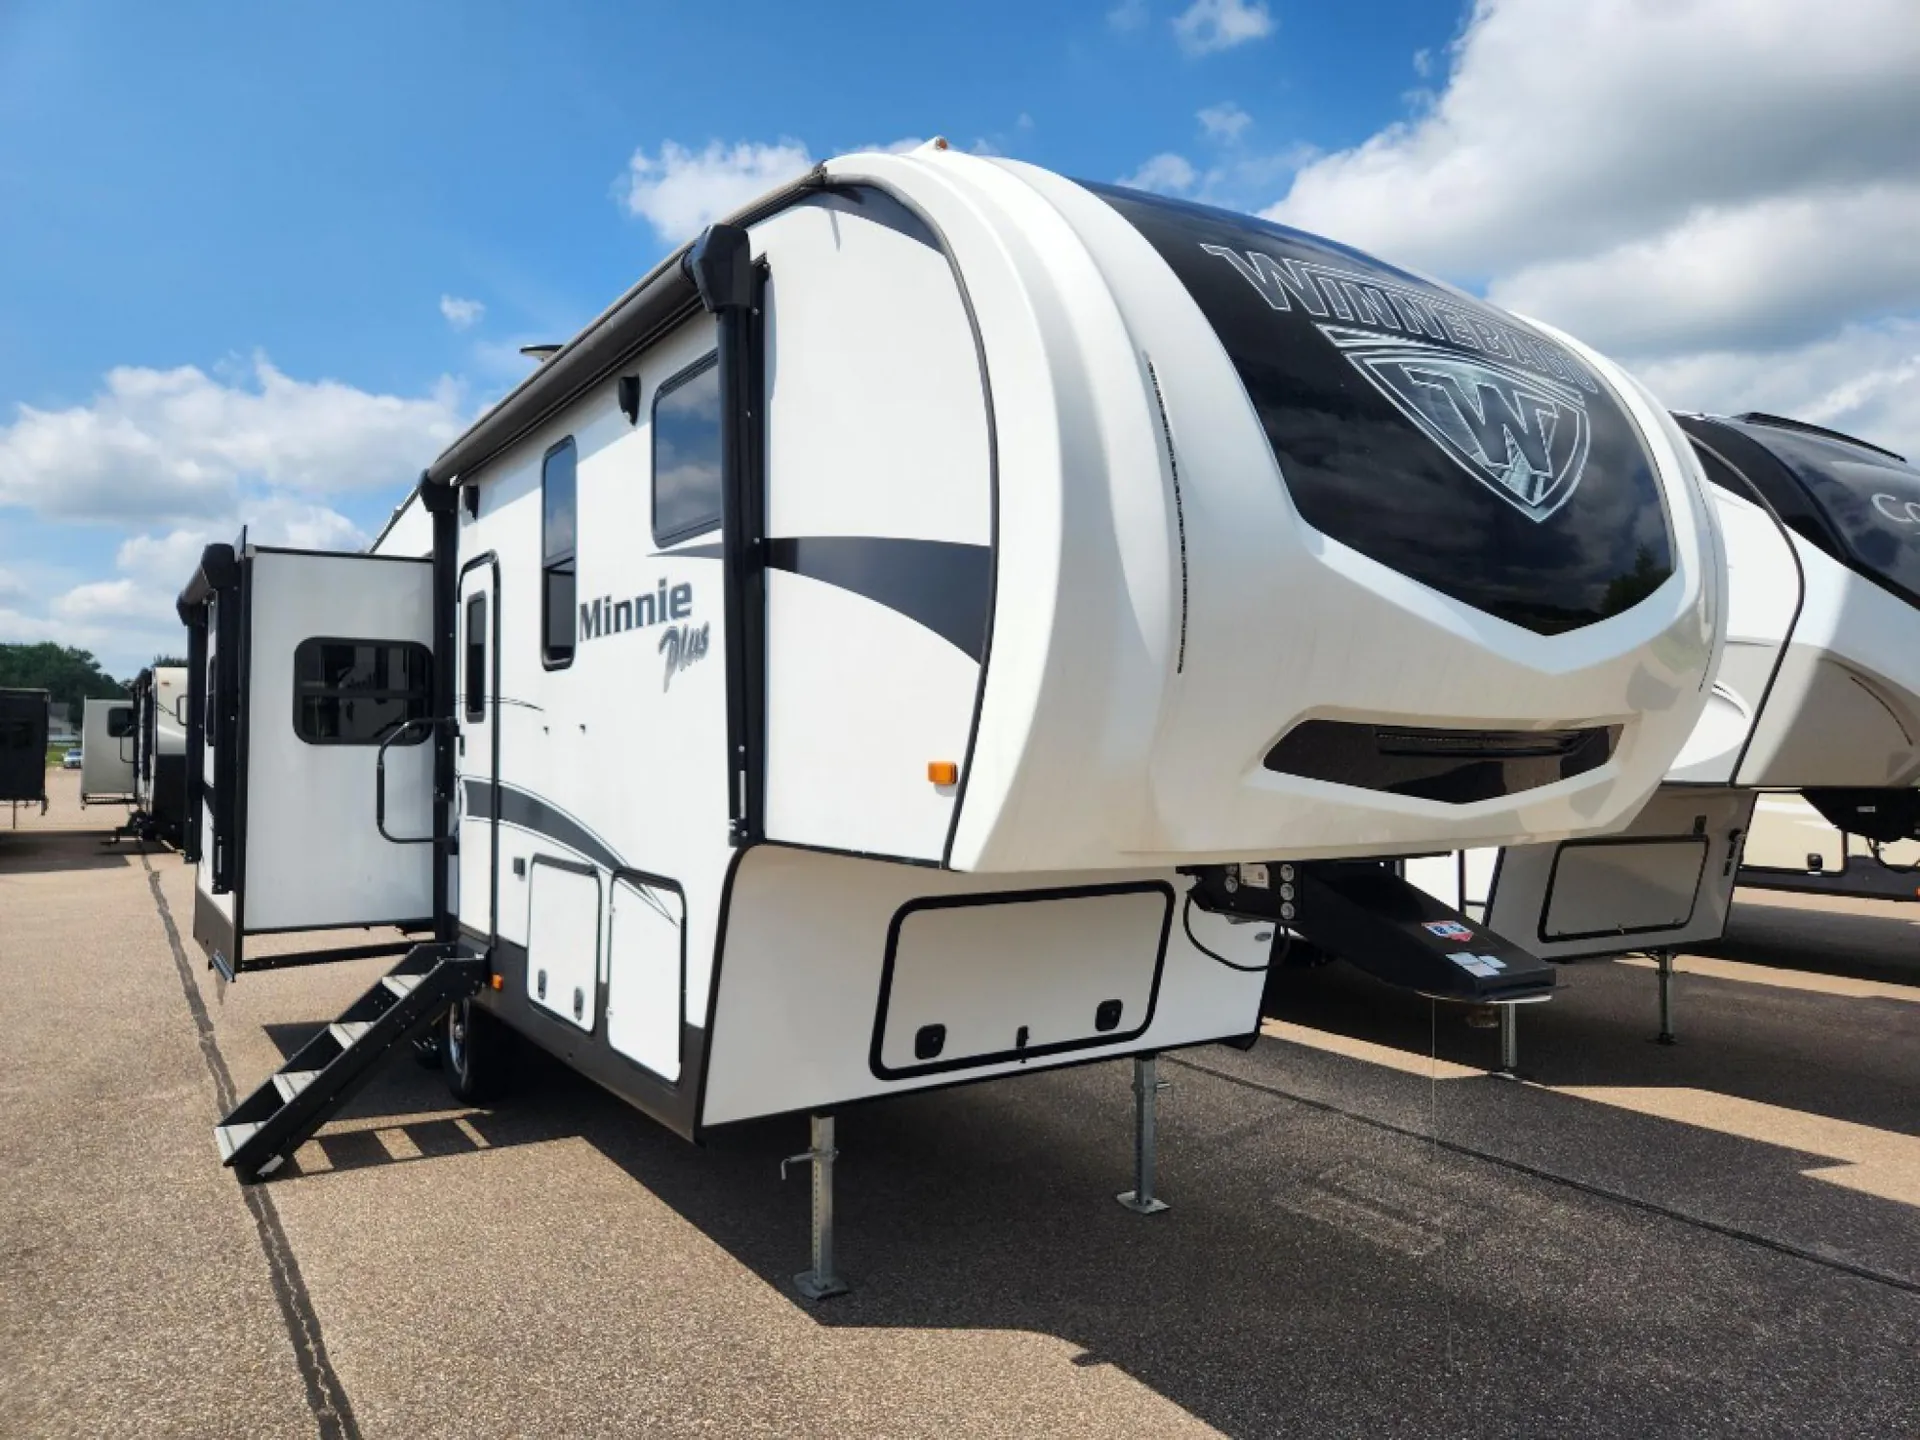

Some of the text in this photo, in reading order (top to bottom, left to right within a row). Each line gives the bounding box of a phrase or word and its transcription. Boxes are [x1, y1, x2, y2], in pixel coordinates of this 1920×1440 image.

[1200, 256, 1598, 393] WINNEBAGO
[1399, 363, 1559, 477] W
[578, 576, 693, 643] Minnie
[657, 620, 710, 694] Plus
